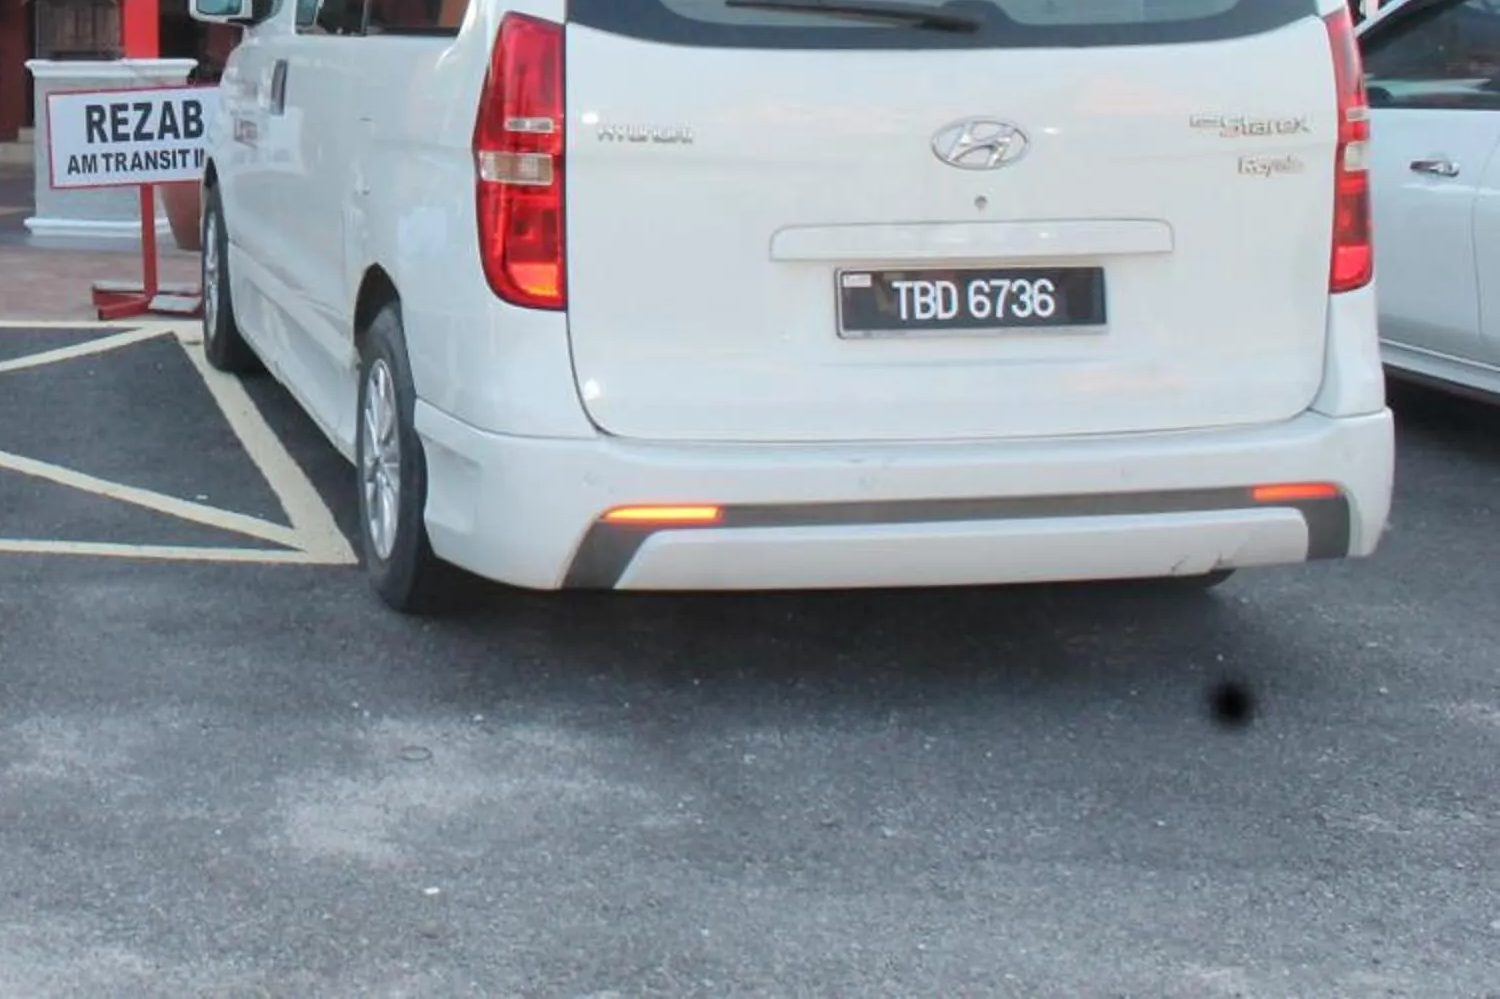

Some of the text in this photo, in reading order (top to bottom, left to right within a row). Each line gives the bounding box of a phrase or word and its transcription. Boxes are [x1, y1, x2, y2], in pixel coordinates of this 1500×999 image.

[85, 99, 204, 143] REZAB
[67, 153, 98, 175] AM
[102, 148, 190, 172] TRANSIT
[892, 278, 1055, 320] TBD 6736
